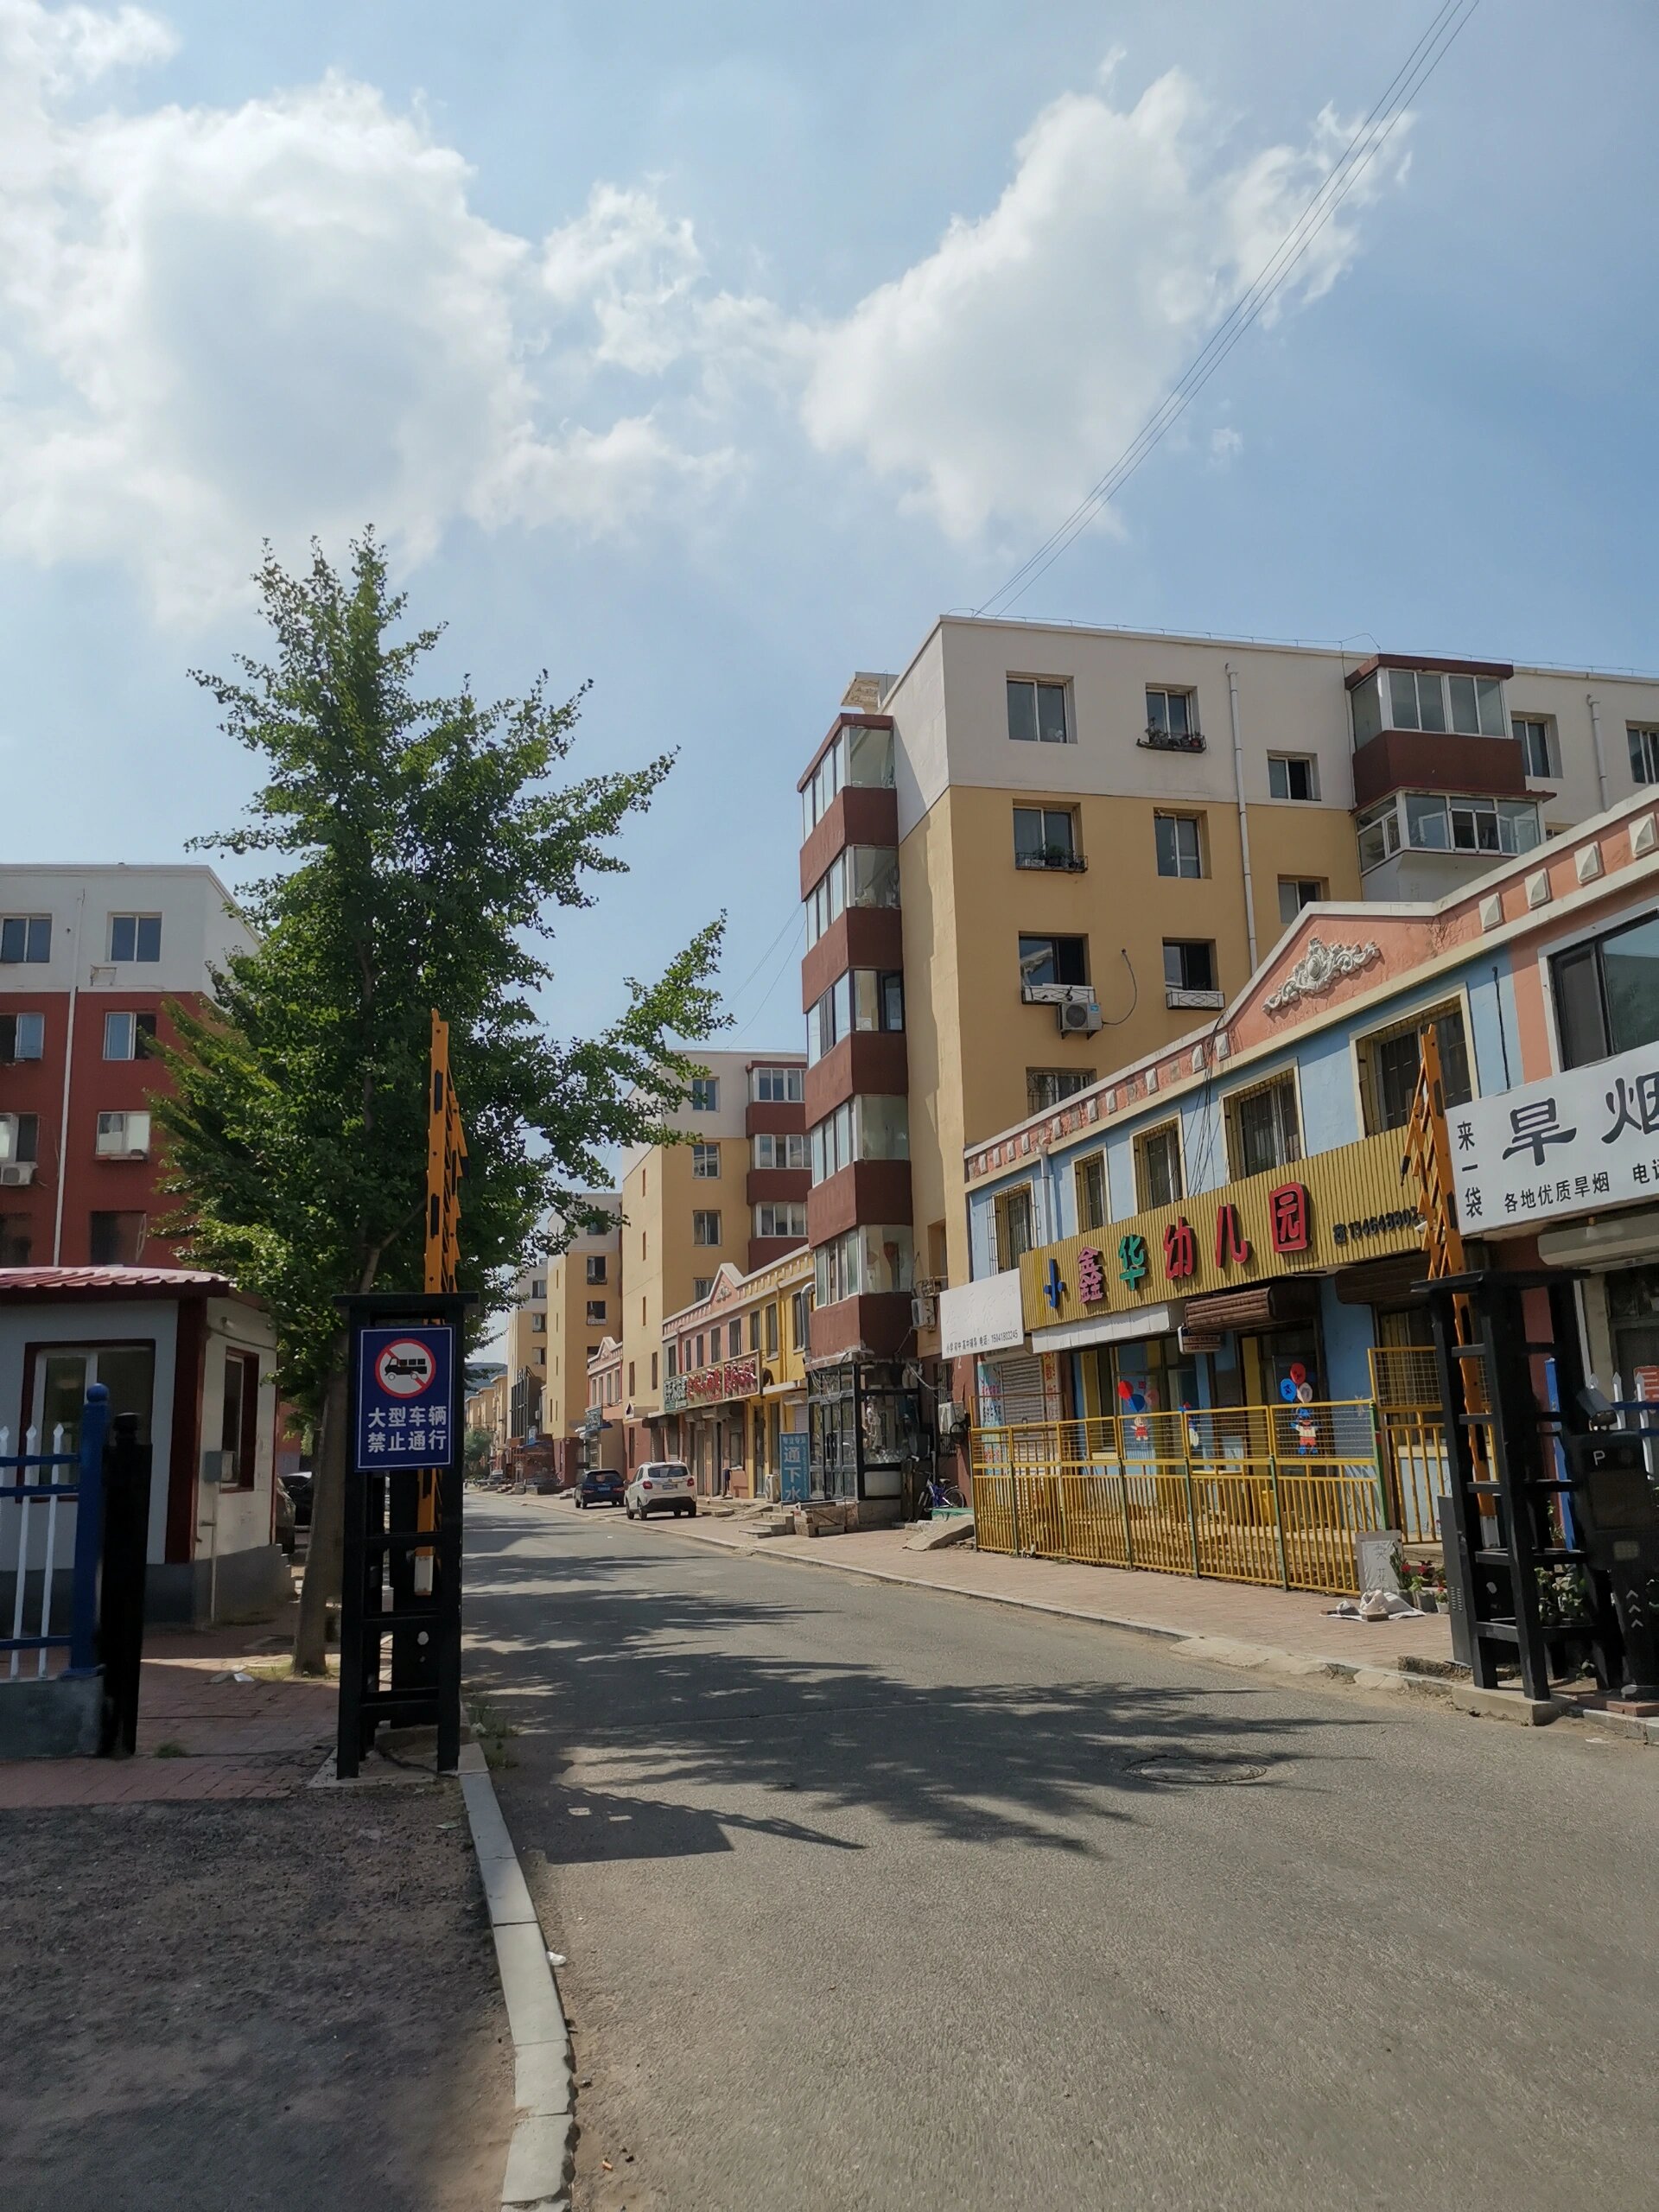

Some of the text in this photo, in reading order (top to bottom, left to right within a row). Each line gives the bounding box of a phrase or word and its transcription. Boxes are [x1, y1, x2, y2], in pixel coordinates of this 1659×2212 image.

[1457, 1121, 1484, 1218] 来一袋
[1503, 1171, 1610, 1213] 各地优质旱烟
[1044, 1181, 1307, 1308] 小鑫华幼儿园
[367, 1405, 447, 1429] 大型车辆
[367, 1429, 447, 1453] 禁止通行
